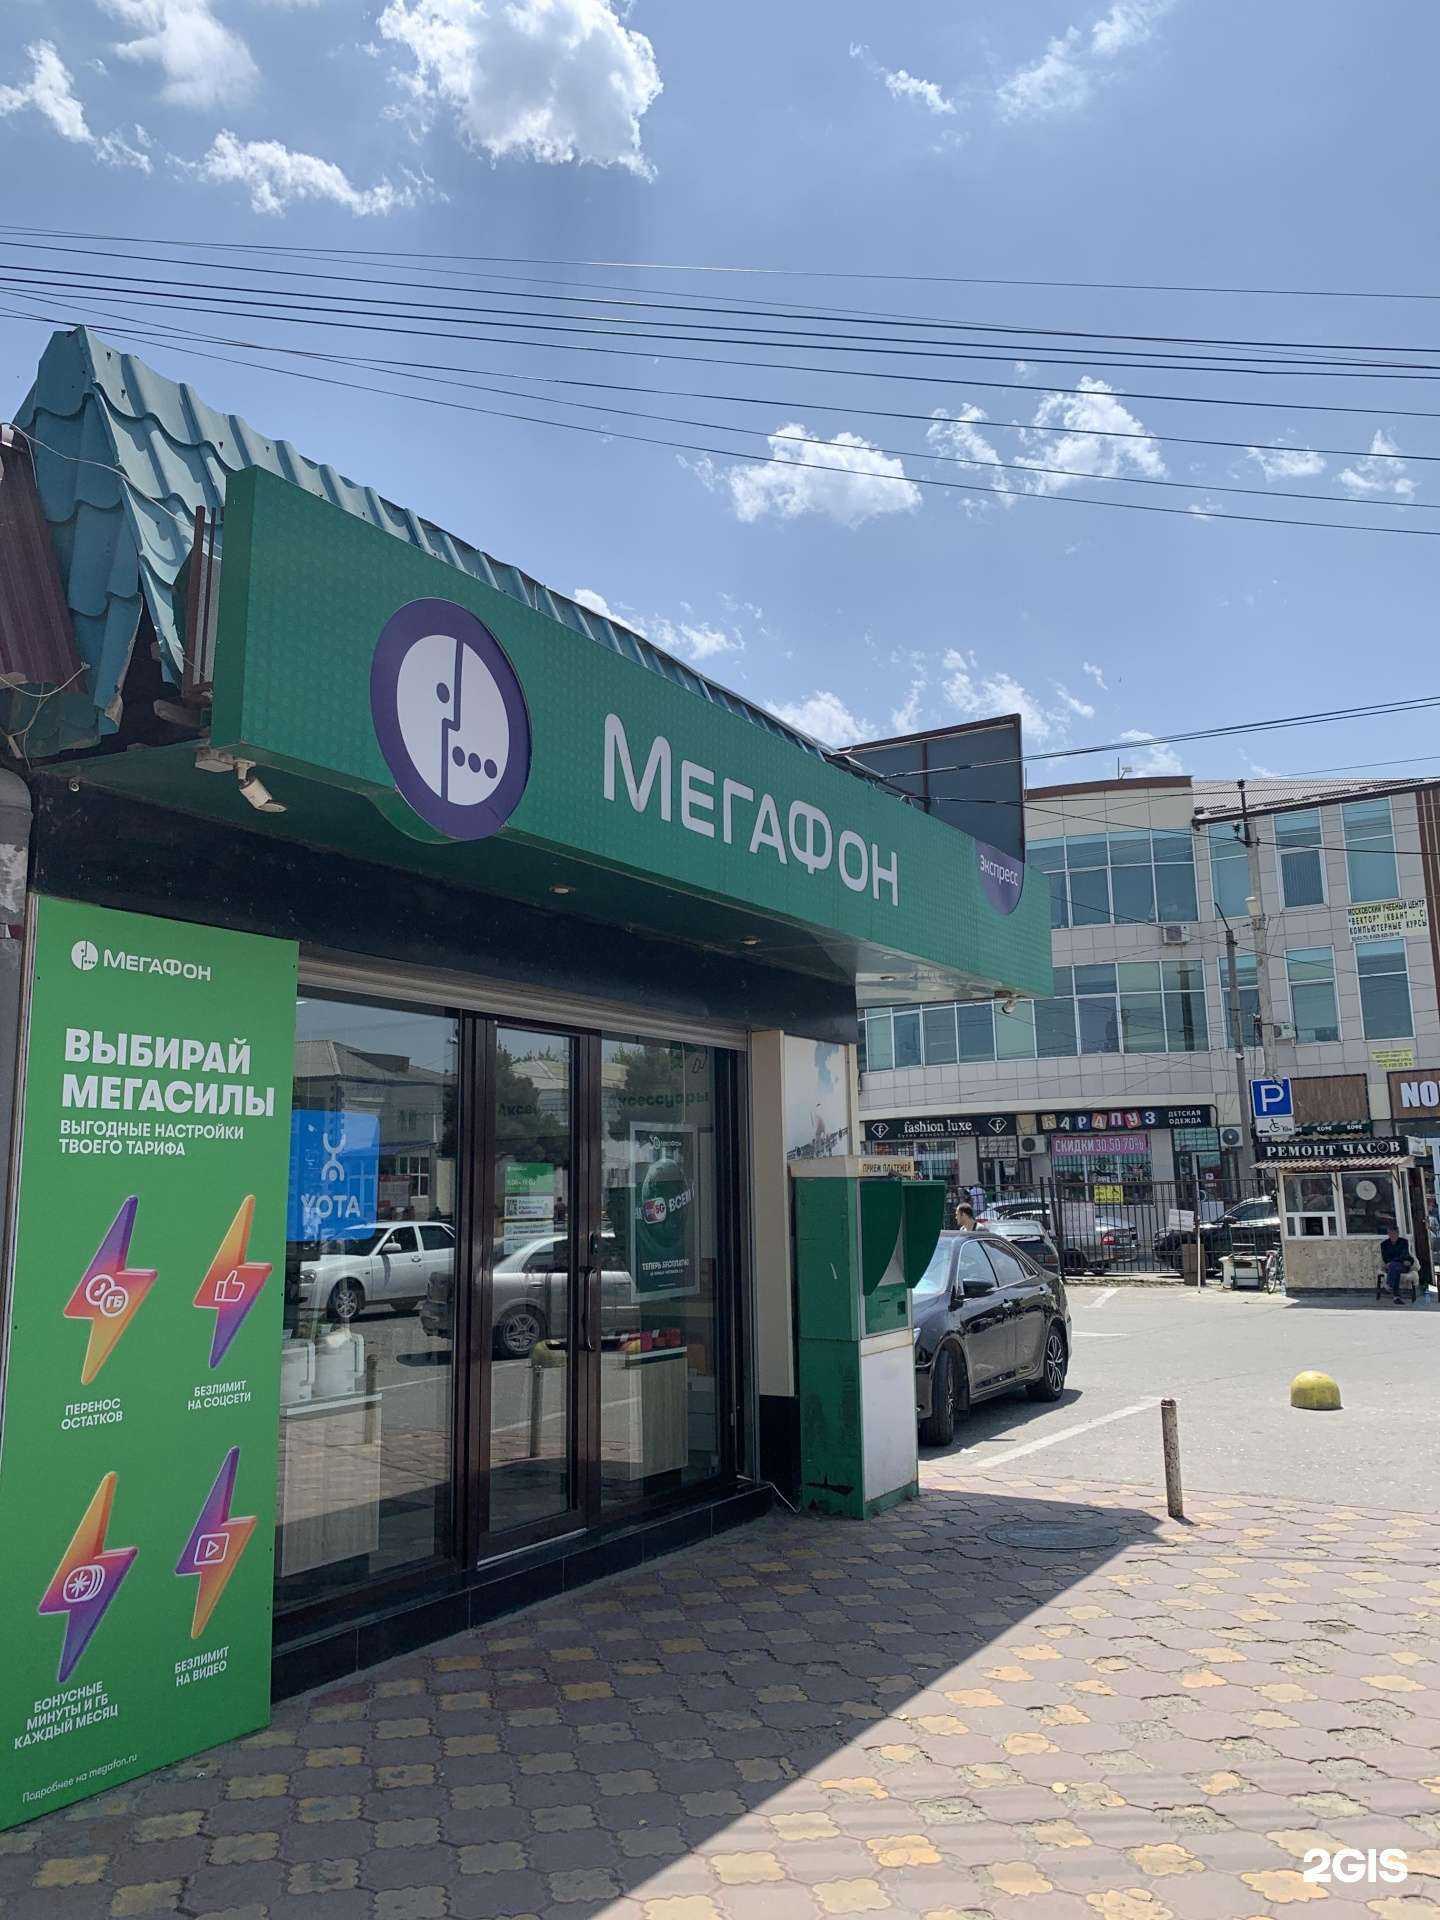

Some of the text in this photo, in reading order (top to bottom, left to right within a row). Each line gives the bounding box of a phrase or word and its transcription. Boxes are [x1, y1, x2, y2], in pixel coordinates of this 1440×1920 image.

[64, 1028, 251, 1075] ВЫБИРАЙ
[61, 1074, 276, 1117] МЕГАСИЛЫ
[1400, 1080, 1440, 1108] NO
[1041, 1110, 1157, 1131] КАРАПУЗ
[1168, 1109, 1201, 1118] ДЕТСКАЯ
[1168, 1117, 1202, 1125] ОДЕЖДА
[60, 1119, 244, 1140] ВЫГОДНЫЕ НАСТРОЙКИ
[903, 1119, 972, 1134] fashion luxe
[59, 1139, 186, 1156] ТВОЕГО ТАРИФА
[1055, 1139, 1095, 1152] СКИДКИ
[1267, 1140, 1401, 1157] РЕМОНТ ЧАСОВ
[300, 1194, 361, 1218] YOTA
[194, 1380, 247, 1397] БЕЗЛИМИТ
[65, 1398, 121, 1416] ПЕРЕНОС
[188, 1391, 252, 1411] НА СОЦСЕТИ
[61, 1411, 123, 1430] ОСТАТКОВ
[174, 1646, 230, 1673] БЕЗЛИМИТ
[176, 1661, 228, 1687] НА ВИДЕО
[34, 1681, 104, 1714] БОНУСНЫЕ
[26, 1694, 109, 1731] МИНУТЫ И ГБ
[14, 1704, 119, 1750] КАЖДЫЙ МЕСЯЦ
[22, 1754, 139, 1803] Подробнее на megafon.ru
